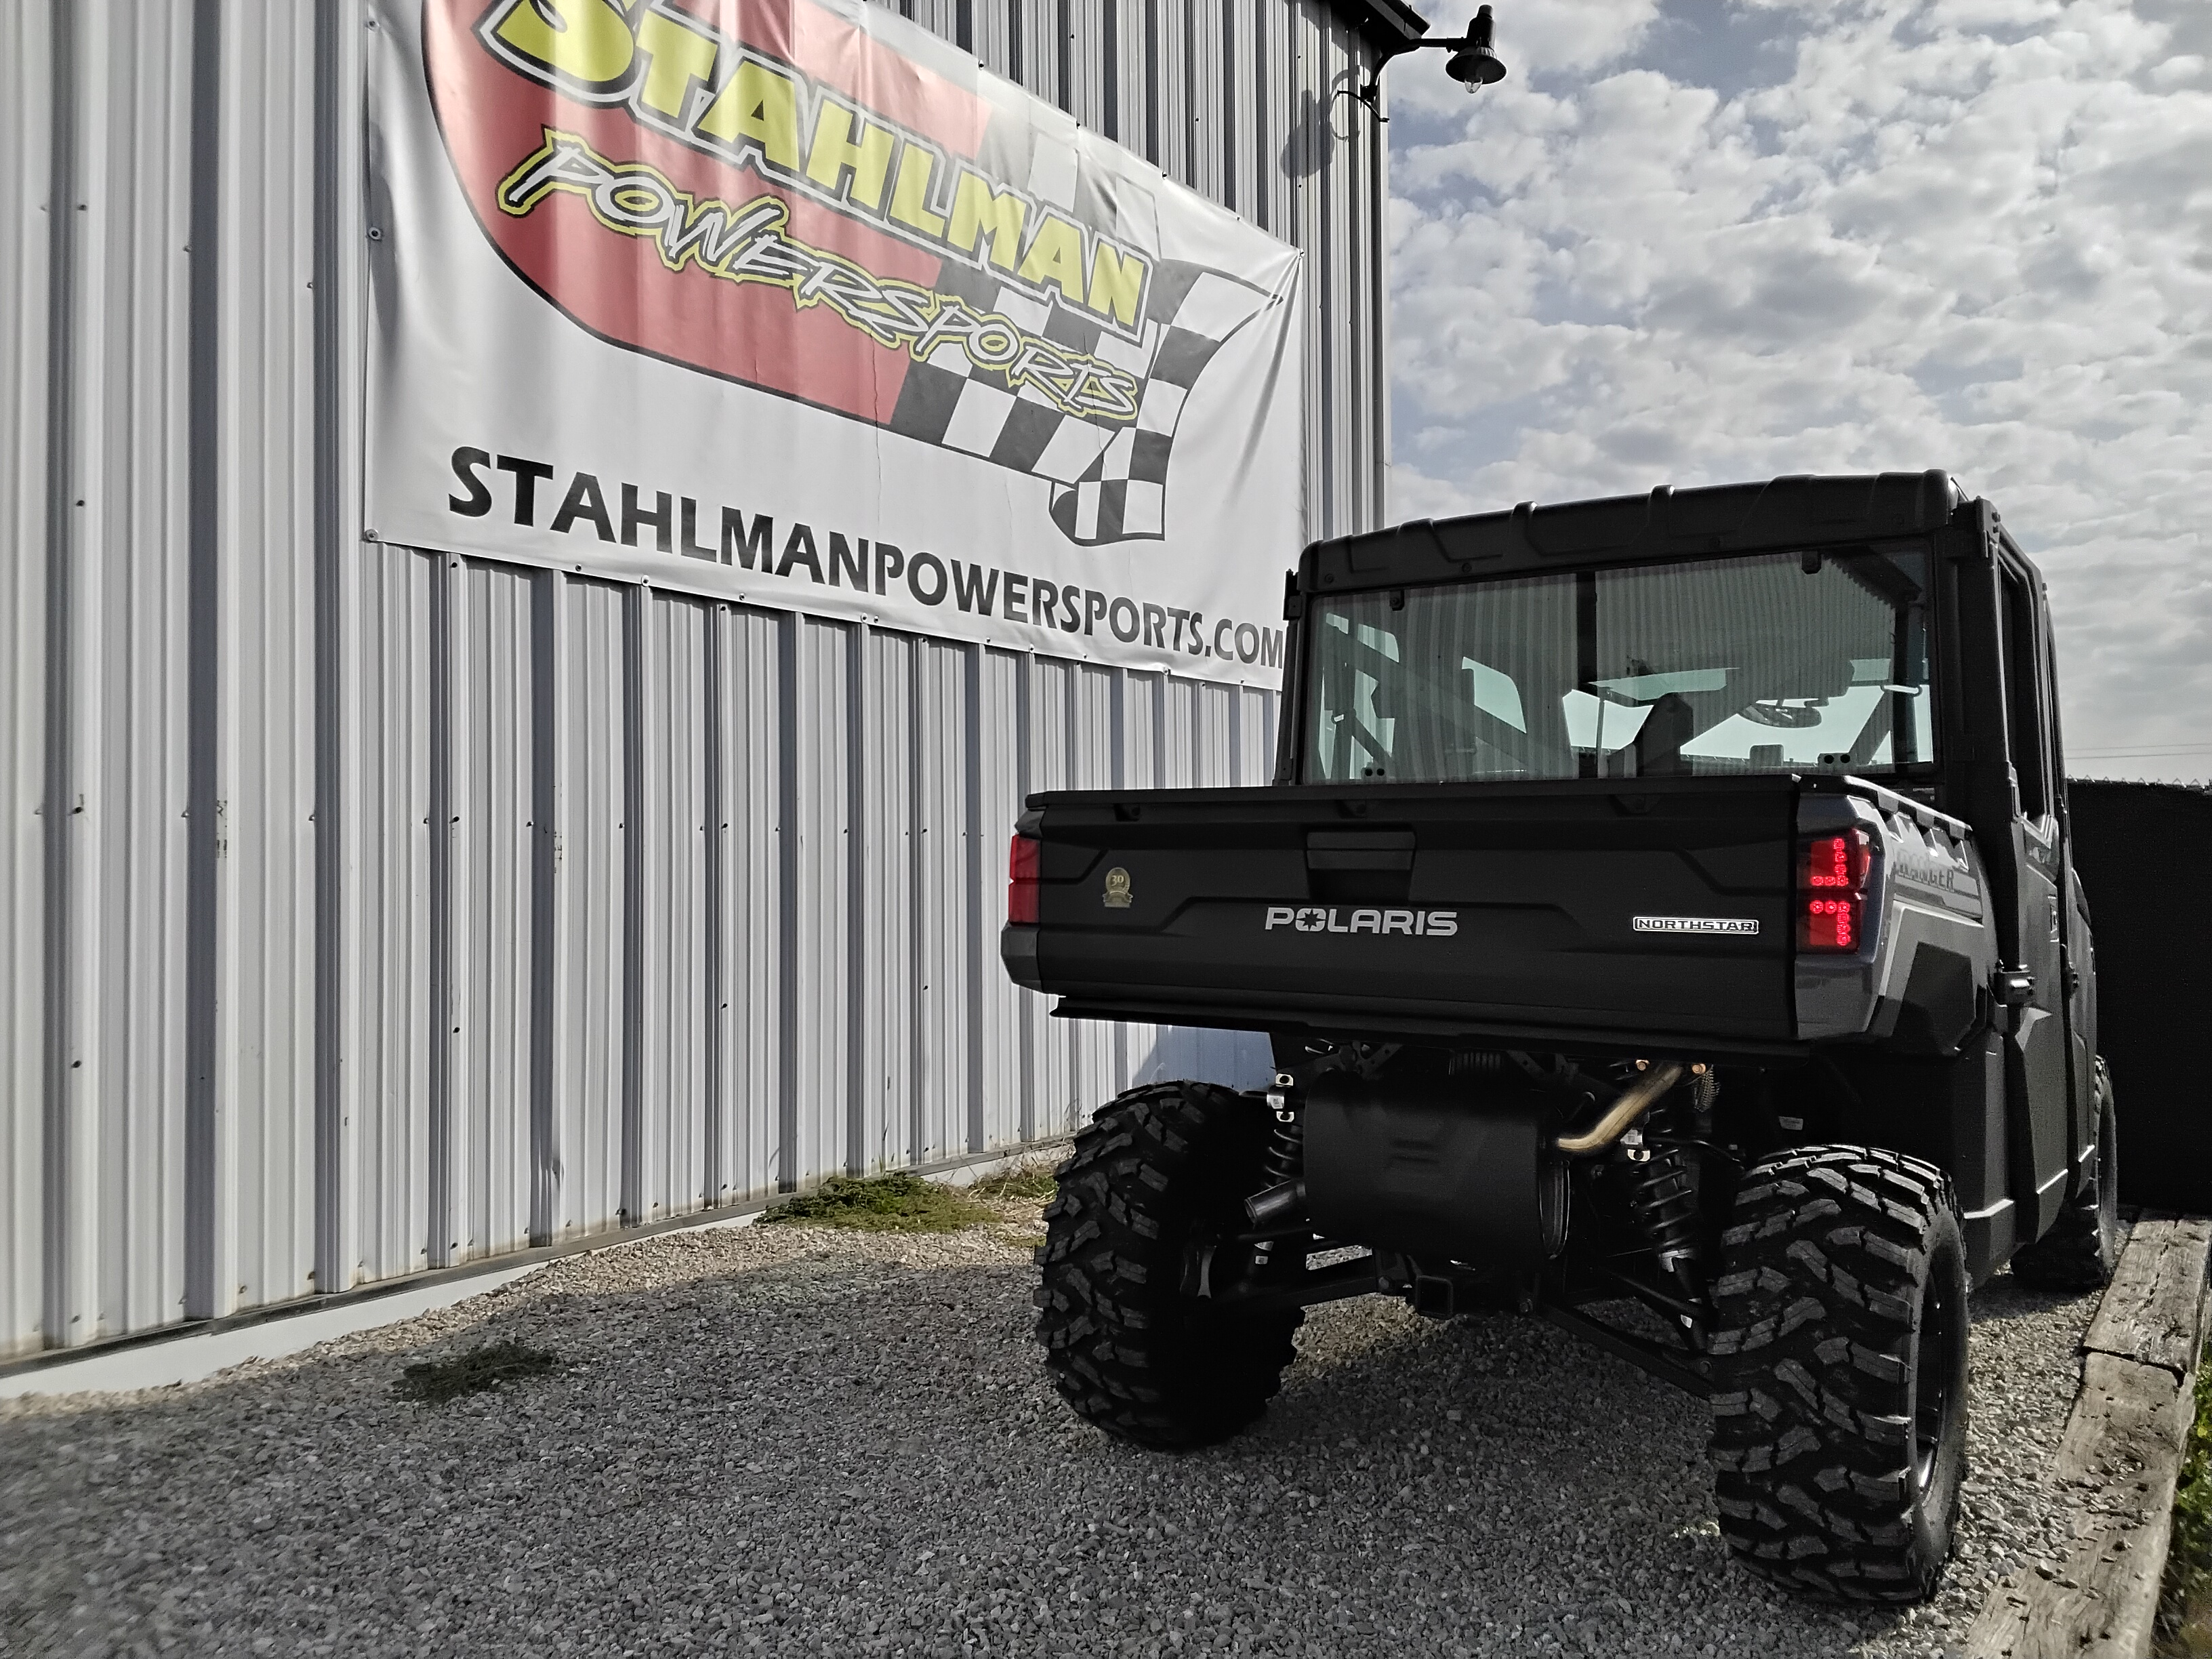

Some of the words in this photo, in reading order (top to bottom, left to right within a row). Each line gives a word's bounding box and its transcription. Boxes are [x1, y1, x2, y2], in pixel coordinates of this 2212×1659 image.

[496, 0, 1146, 327] STAHLMAN
[506, 138, 1137, 417] POWERSPORTS
[449, 446, 1283, 670] STAHLMANPOWERSPORTS.COM
[1111, 875, 1124, 886] 30
[1265, 907, 1458, 936] POLARIS
[1638, 920, 1753, 931] NORTHSTAR
